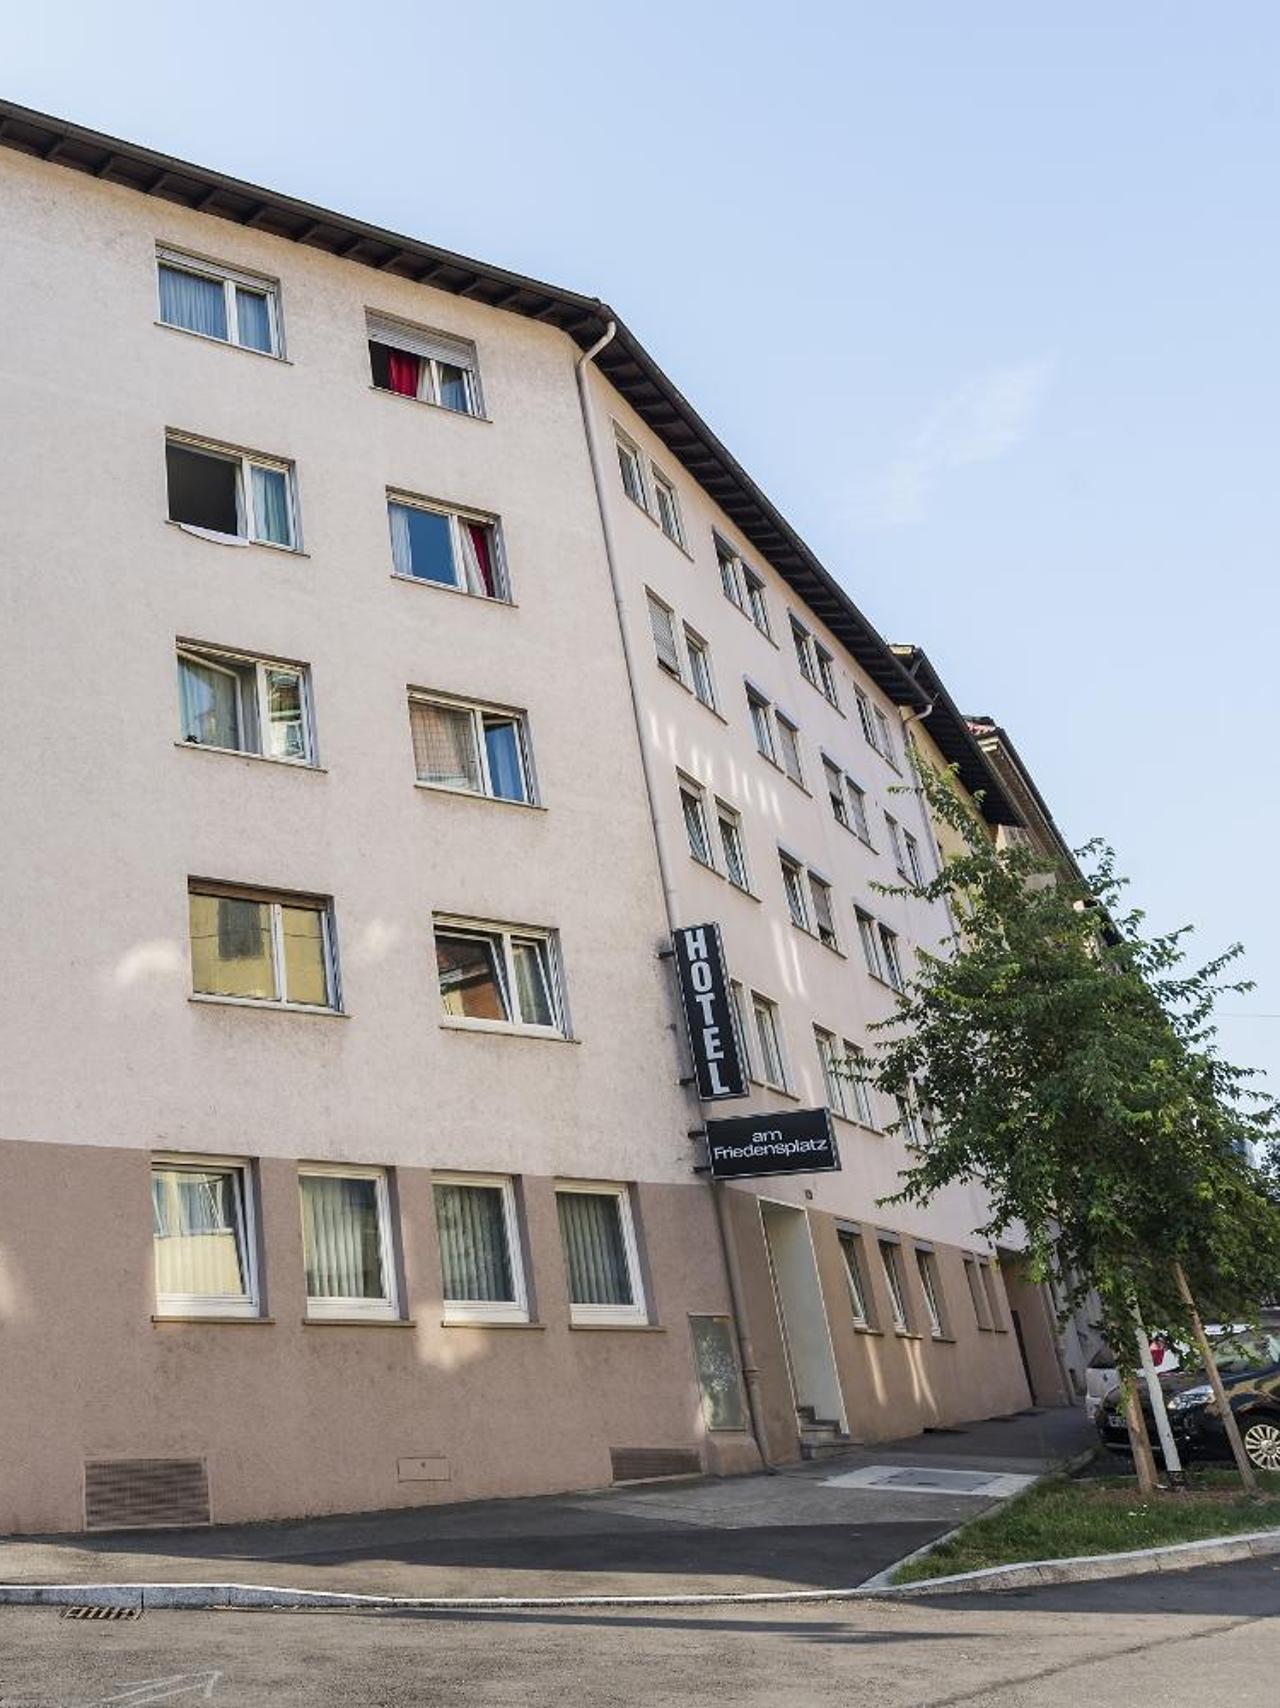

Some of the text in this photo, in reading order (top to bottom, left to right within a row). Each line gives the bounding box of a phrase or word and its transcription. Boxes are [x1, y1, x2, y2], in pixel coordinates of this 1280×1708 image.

[683, 929, 730, 1095] HOTEL
[752, 1129, 783, 1143] am
[714, 1138, 828, 1160] Friedensplatz
